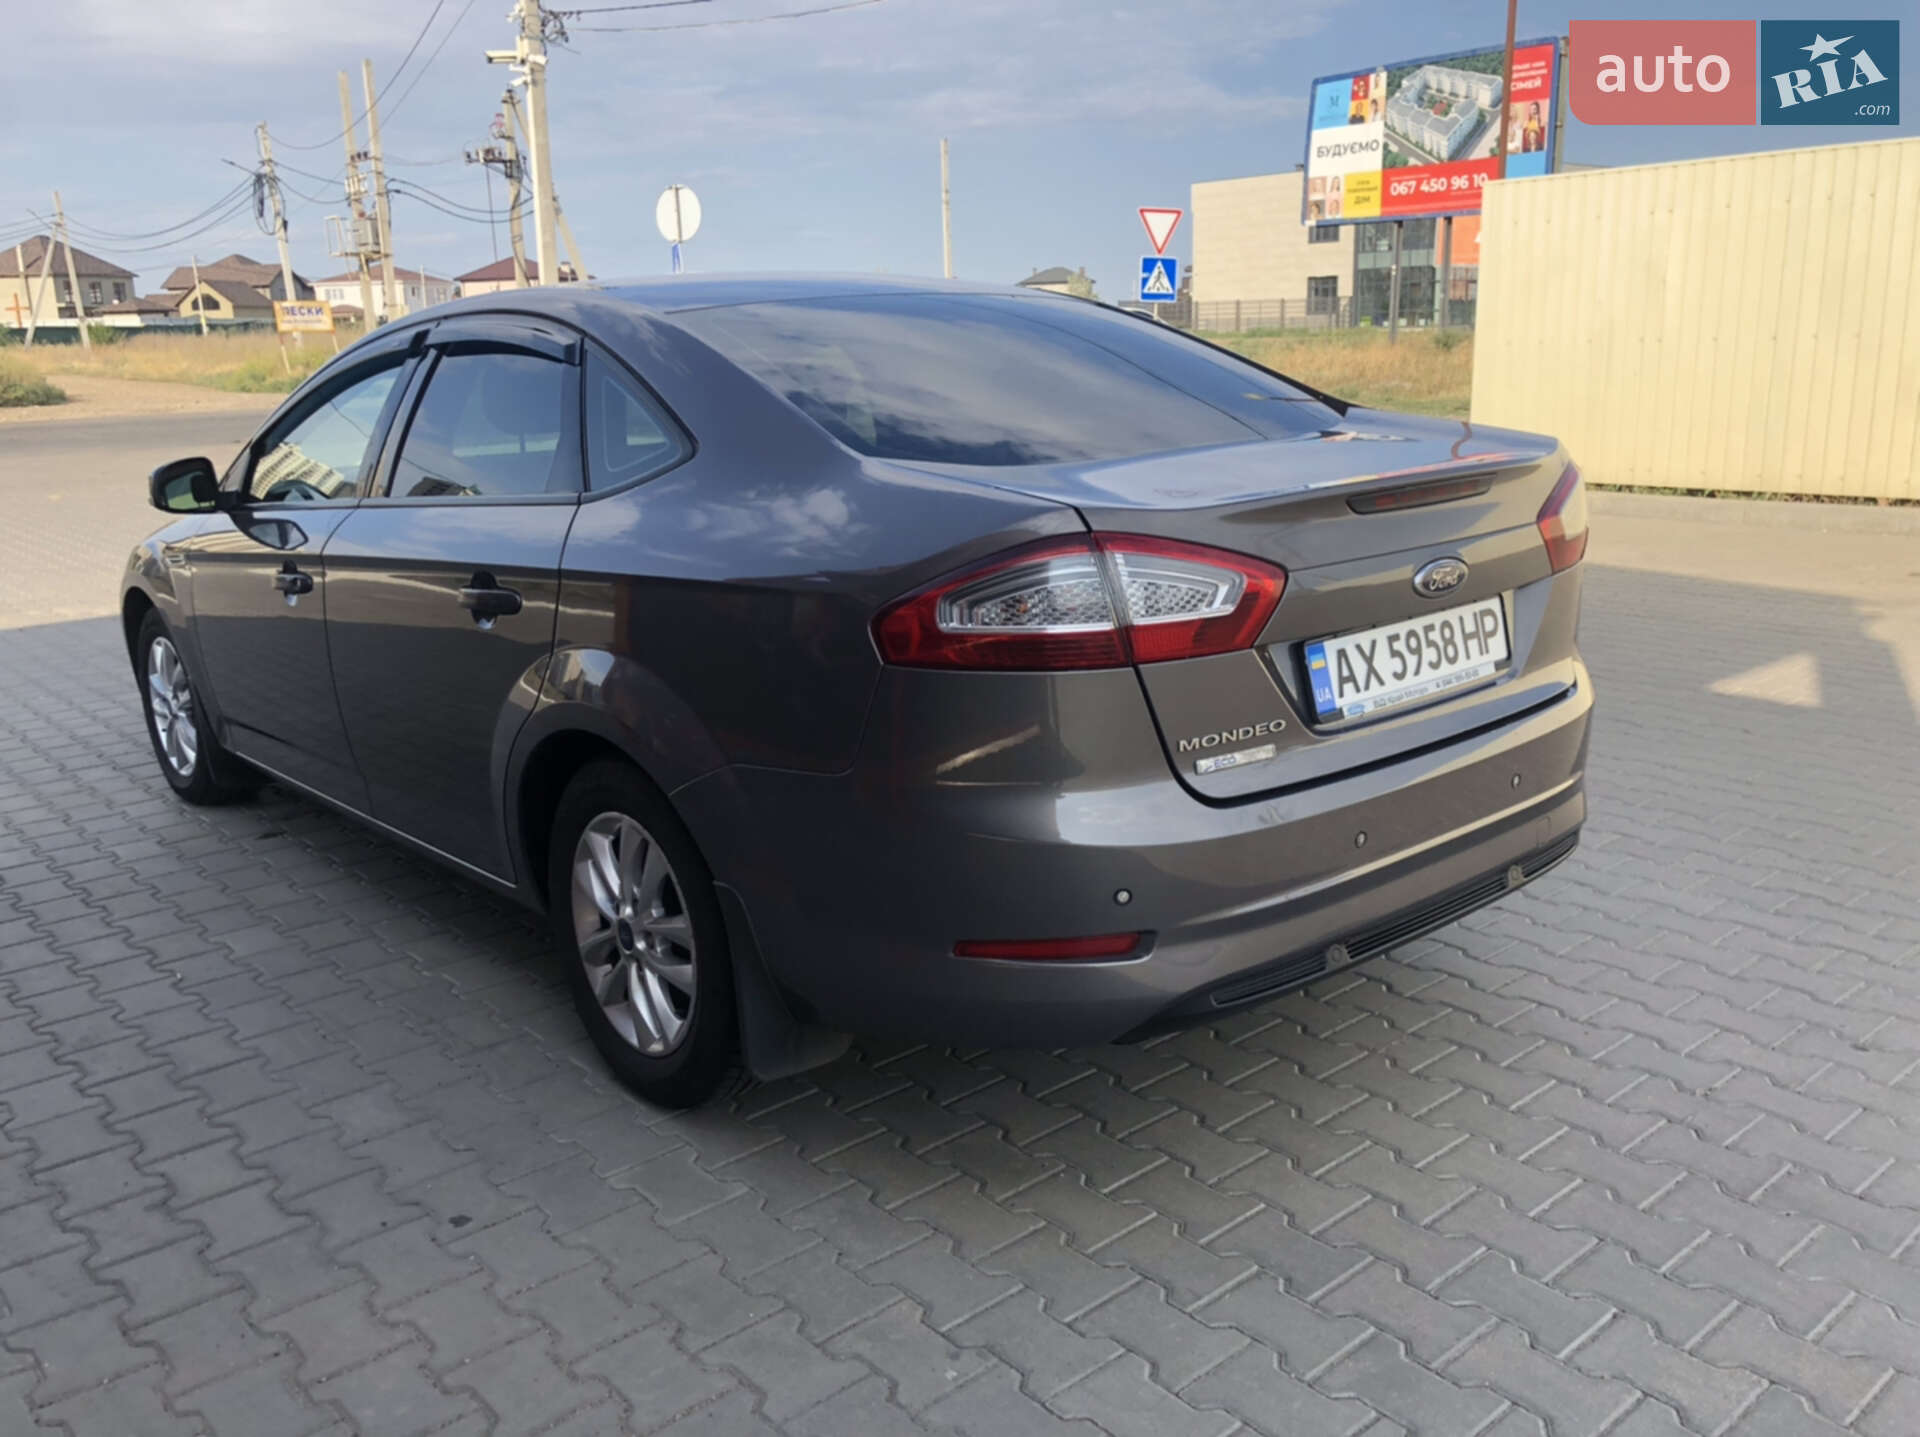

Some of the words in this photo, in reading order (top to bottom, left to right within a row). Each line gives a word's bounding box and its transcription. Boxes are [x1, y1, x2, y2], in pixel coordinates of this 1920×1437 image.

[1316, 139, 1380, 158] БУДУЄМО
[1390, 180, 1417, 196] 067
[1419, 177, 1448, 193] 450
[1450, 174, 1470, 190] 96
[1472, 172, 1489, 189] 10
[1336, 639, 1385, 698] AX
[1386, 620, 1460, 681] 5958
[1459, 608, 1499, 660] HP
[1317, 687, 1332, 703] UA
[1179, 719, 1287, 752] MONDEO
